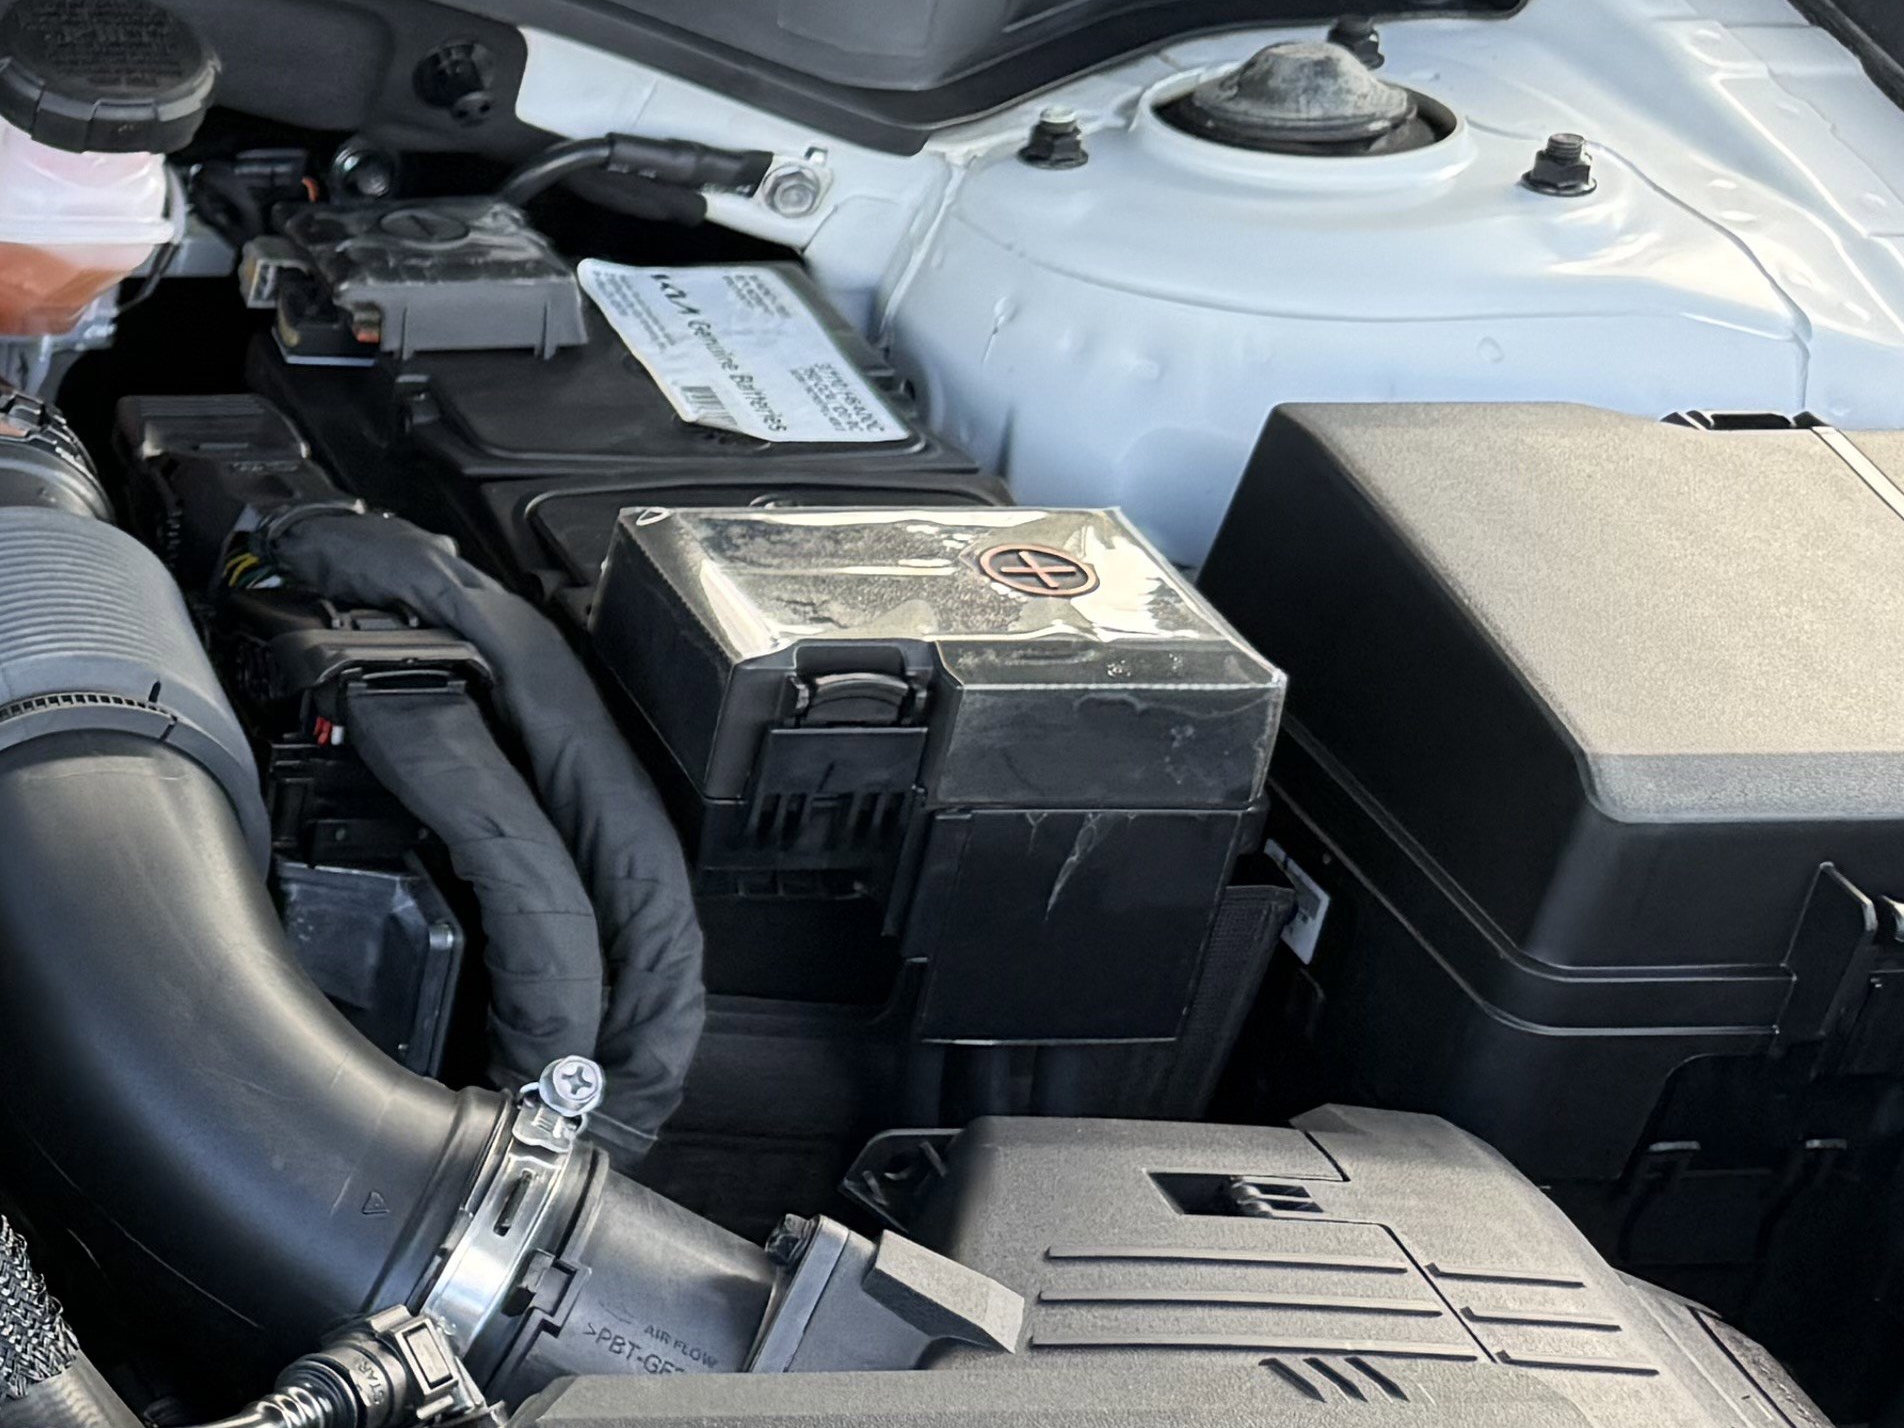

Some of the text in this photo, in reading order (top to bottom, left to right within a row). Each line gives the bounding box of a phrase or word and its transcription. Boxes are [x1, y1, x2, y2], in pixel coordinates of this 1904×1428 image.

[583, 1322, 688, 1374] >PBT-GF
[644, 1324, 719, 1370] AIR FLOW
